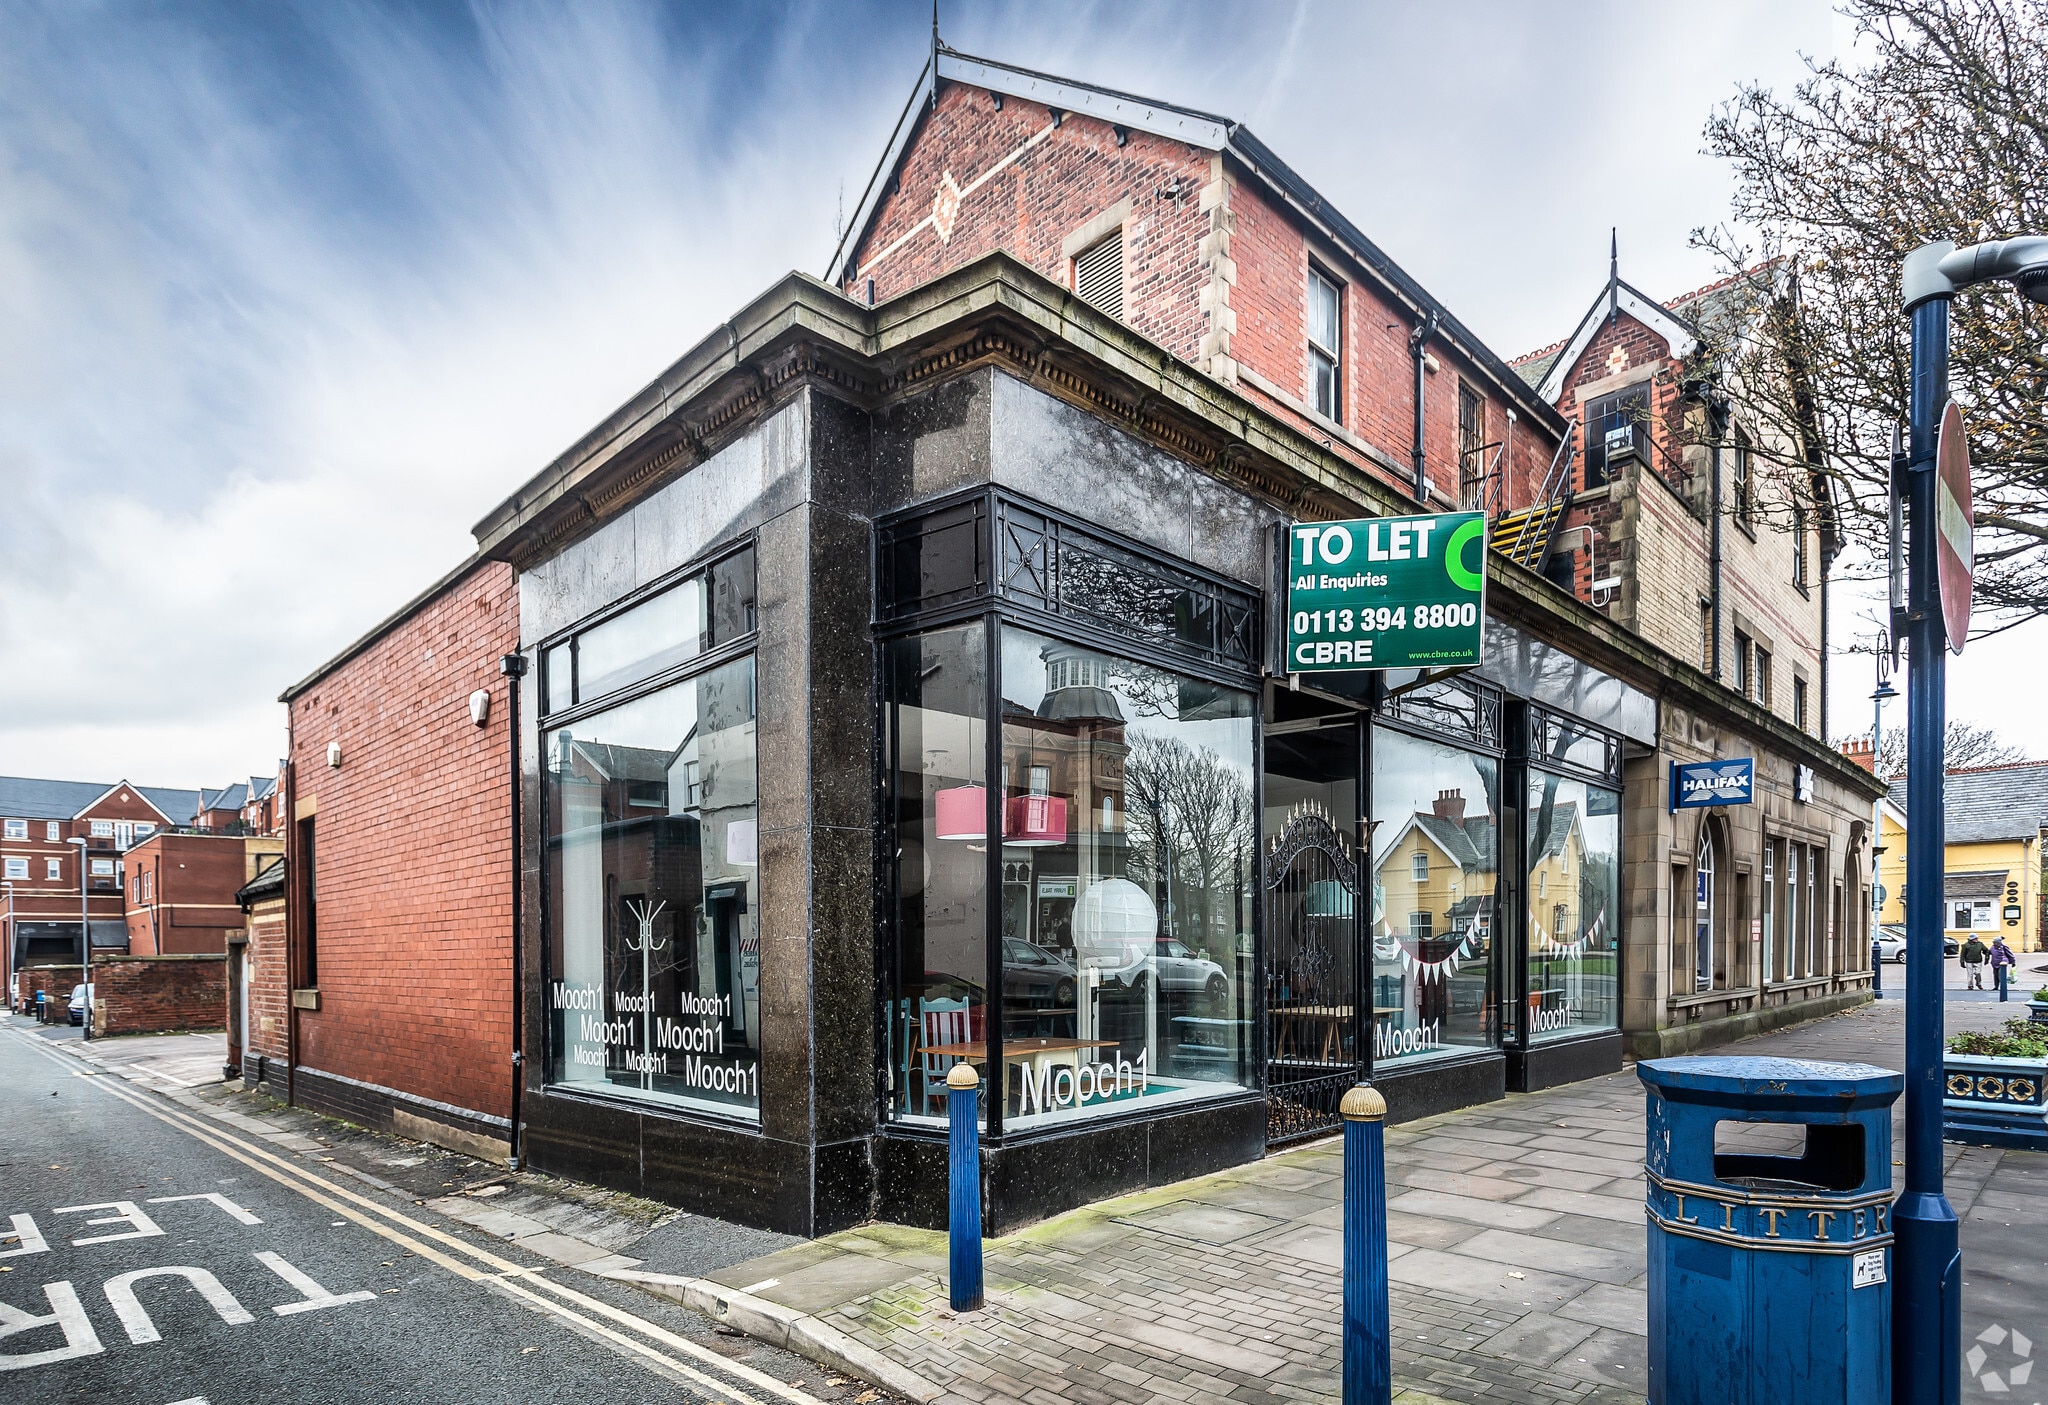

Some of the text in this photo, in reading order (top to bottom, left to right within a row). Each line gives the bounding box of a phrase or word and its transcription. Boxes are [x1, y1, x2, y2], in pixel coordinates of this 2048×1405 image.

[1297, 519, 1436, 566] TO LET
[1296, 571, 1388, 592] All Enquiries
[1293, 602, 1477, 635] 0113 394 8800
[1295, 639, 1373, 664] CBRE
[1408, 648, 1473, 660] www.cbre.co.uk
[1683, 775, 1749, 791] HALIFAX
[553, 982, 603, 1011] Mooch1
[615, 991, 655, 1013] Mooch1
[681, 991, 730, 1016] Mooch1
[580, 1014, 634, 1046] Mooch1
[1529, 1001, 1570, 1033] Mooch1
[656, 1016, 723, 1054] Mooch1
[1376, 1017, 1439, 1057] Mooch1
[574, 1044, 609, 1067] Mooch1
[625, 1049, 667, 1074] Mooch1
[685, 1054, 757, 1096] Mooch1
[1021, 1046, 1148, 1111] Mooch1
[1675, 1194, 1888, 1240] LITTER
